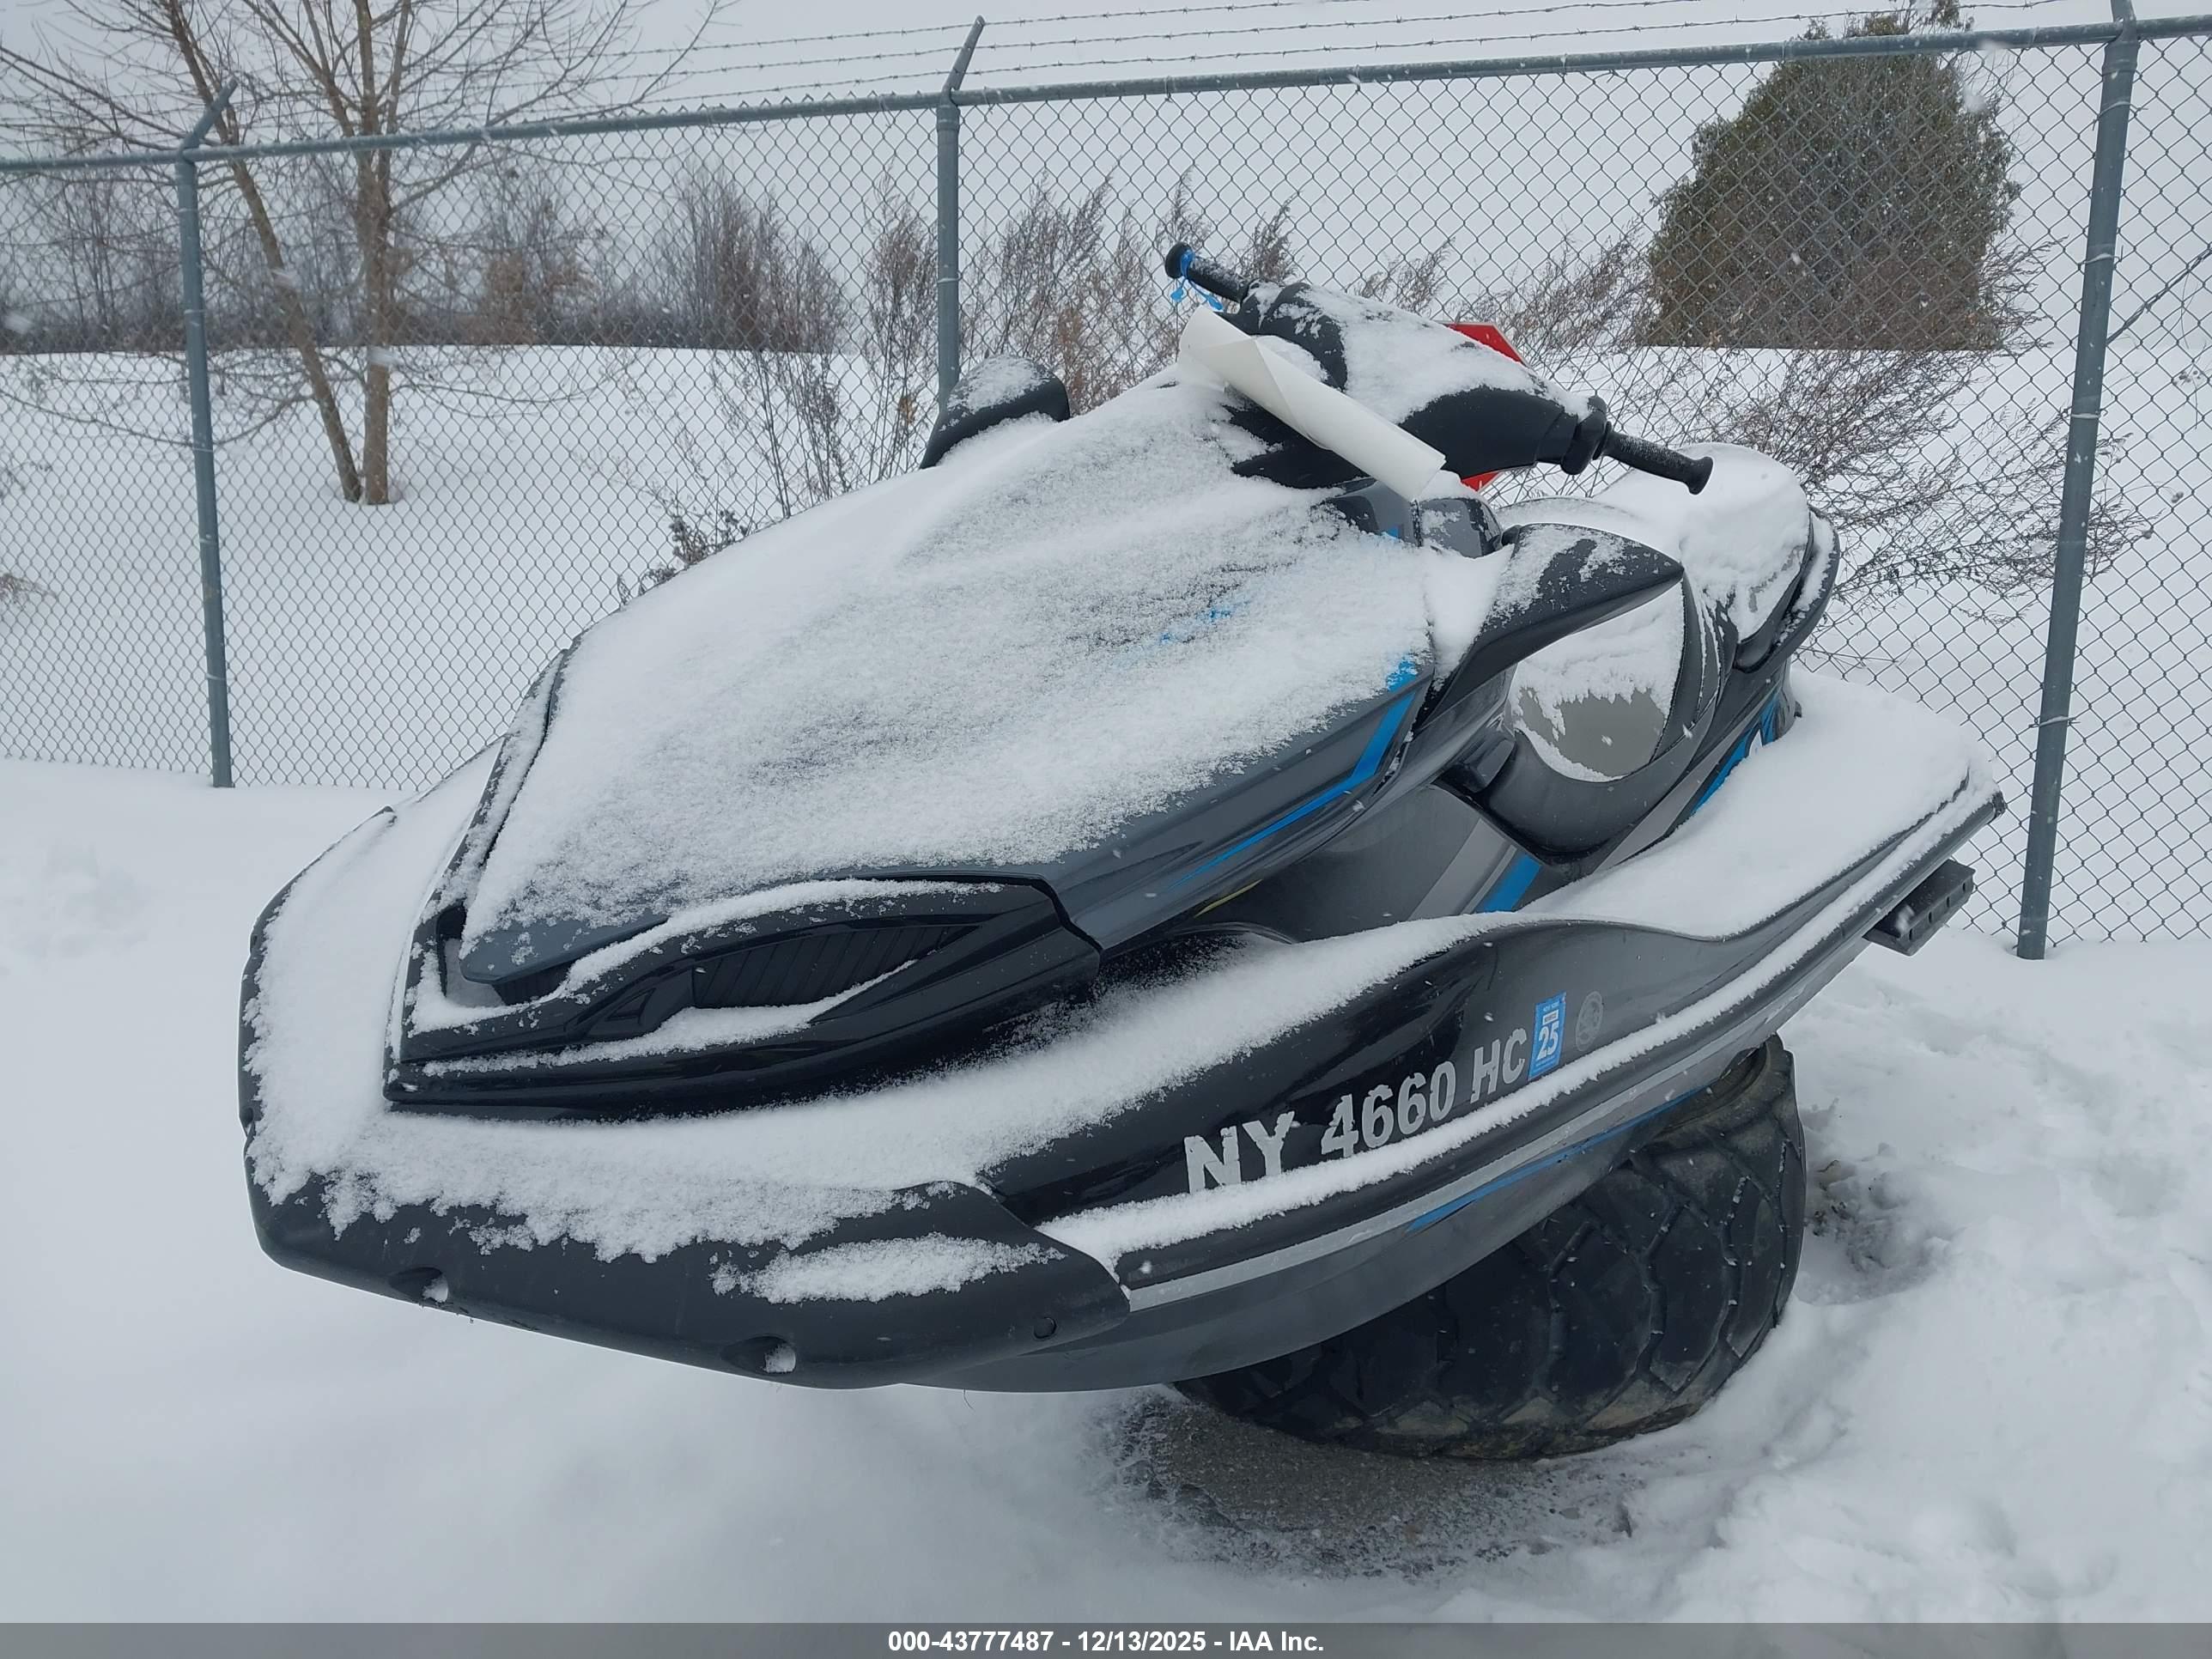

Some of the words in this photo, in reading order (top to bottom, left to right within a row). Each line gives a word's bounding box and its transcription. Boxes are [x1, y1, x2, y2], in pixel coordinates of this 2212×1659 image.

[1536, 1020, 1560, 1061] 25
[1184, 1110, 1295, 1194] NY
[1321, 1060, 1456, 1158] 4660
[1470, 1028, 1527, 1103] HC
